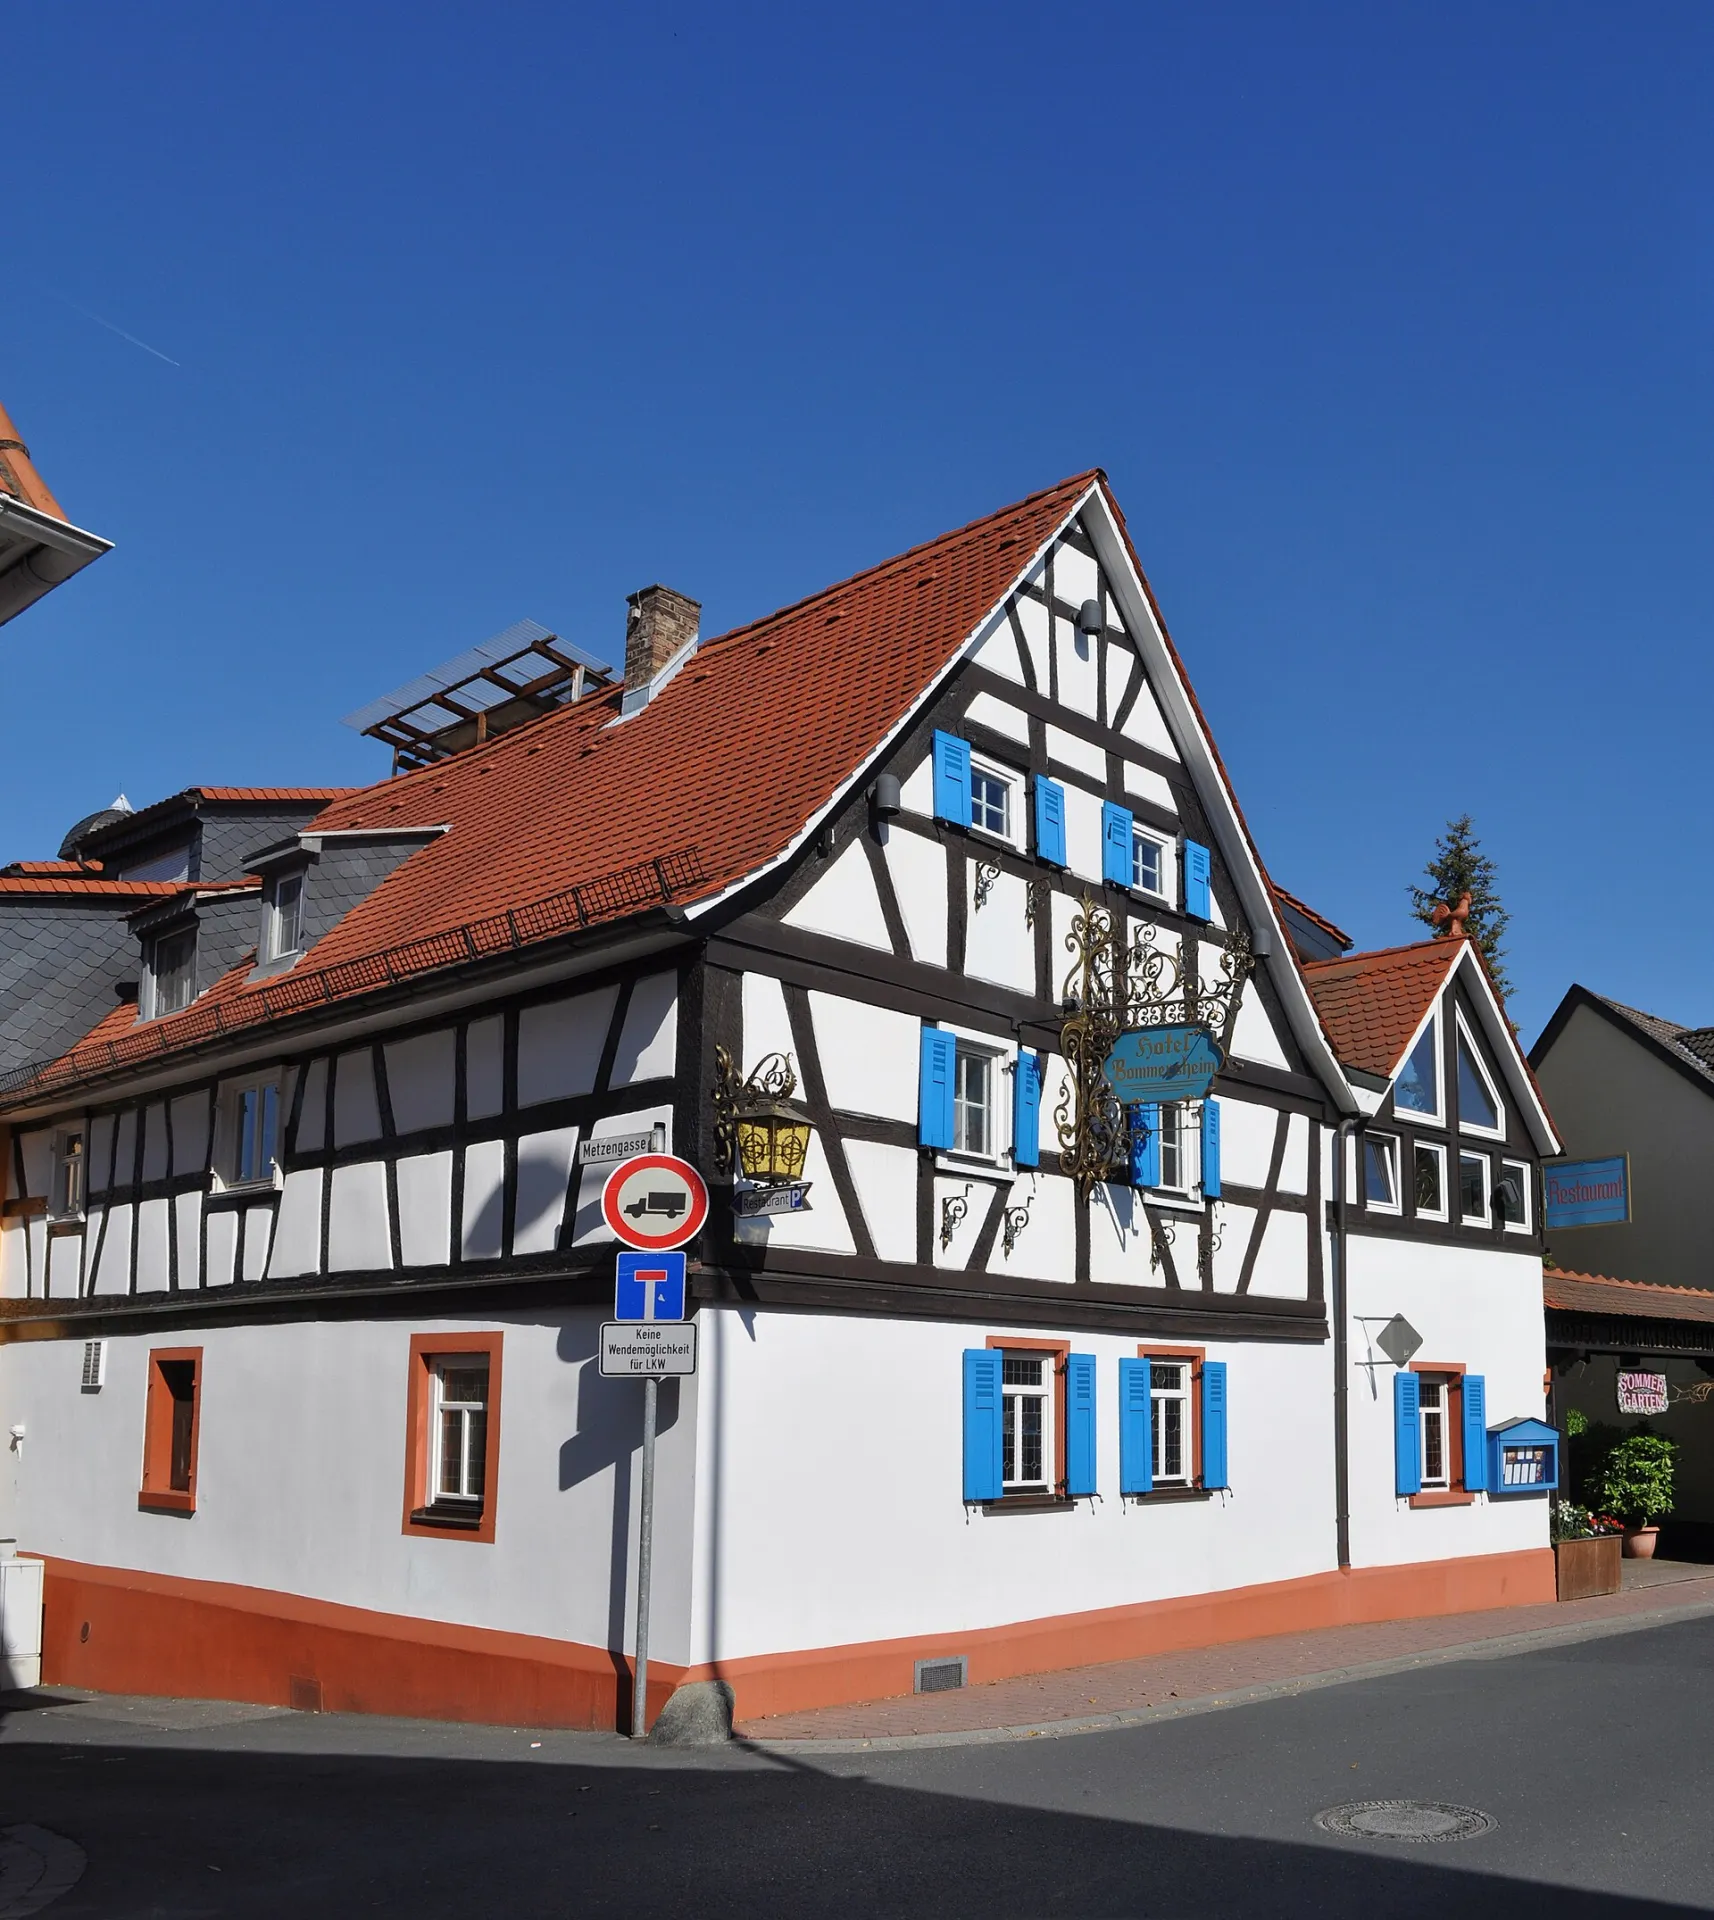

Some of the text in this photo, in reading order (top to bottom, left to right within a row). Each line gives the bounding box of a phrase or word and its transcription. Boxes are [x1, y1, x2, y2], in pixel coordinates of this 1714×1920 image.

[1136, 1032, 1190, 1059] Hotel
[583, 1139, 646, 1158] Metzengasse
[1548, 1174, 1624, 1207] Restaurant
[743, 1194, 789, 1209] Restaurant
[636, 1328, 661, 1340] Keine
[608, 1343, 690, 1358] Wendemöglichkeit
[630, 1358, 666, 1370] für LKW
[1620, 1373, 1665, 1394] SOMMER
[1623, 1392, 1664, 1408] GARTEN
